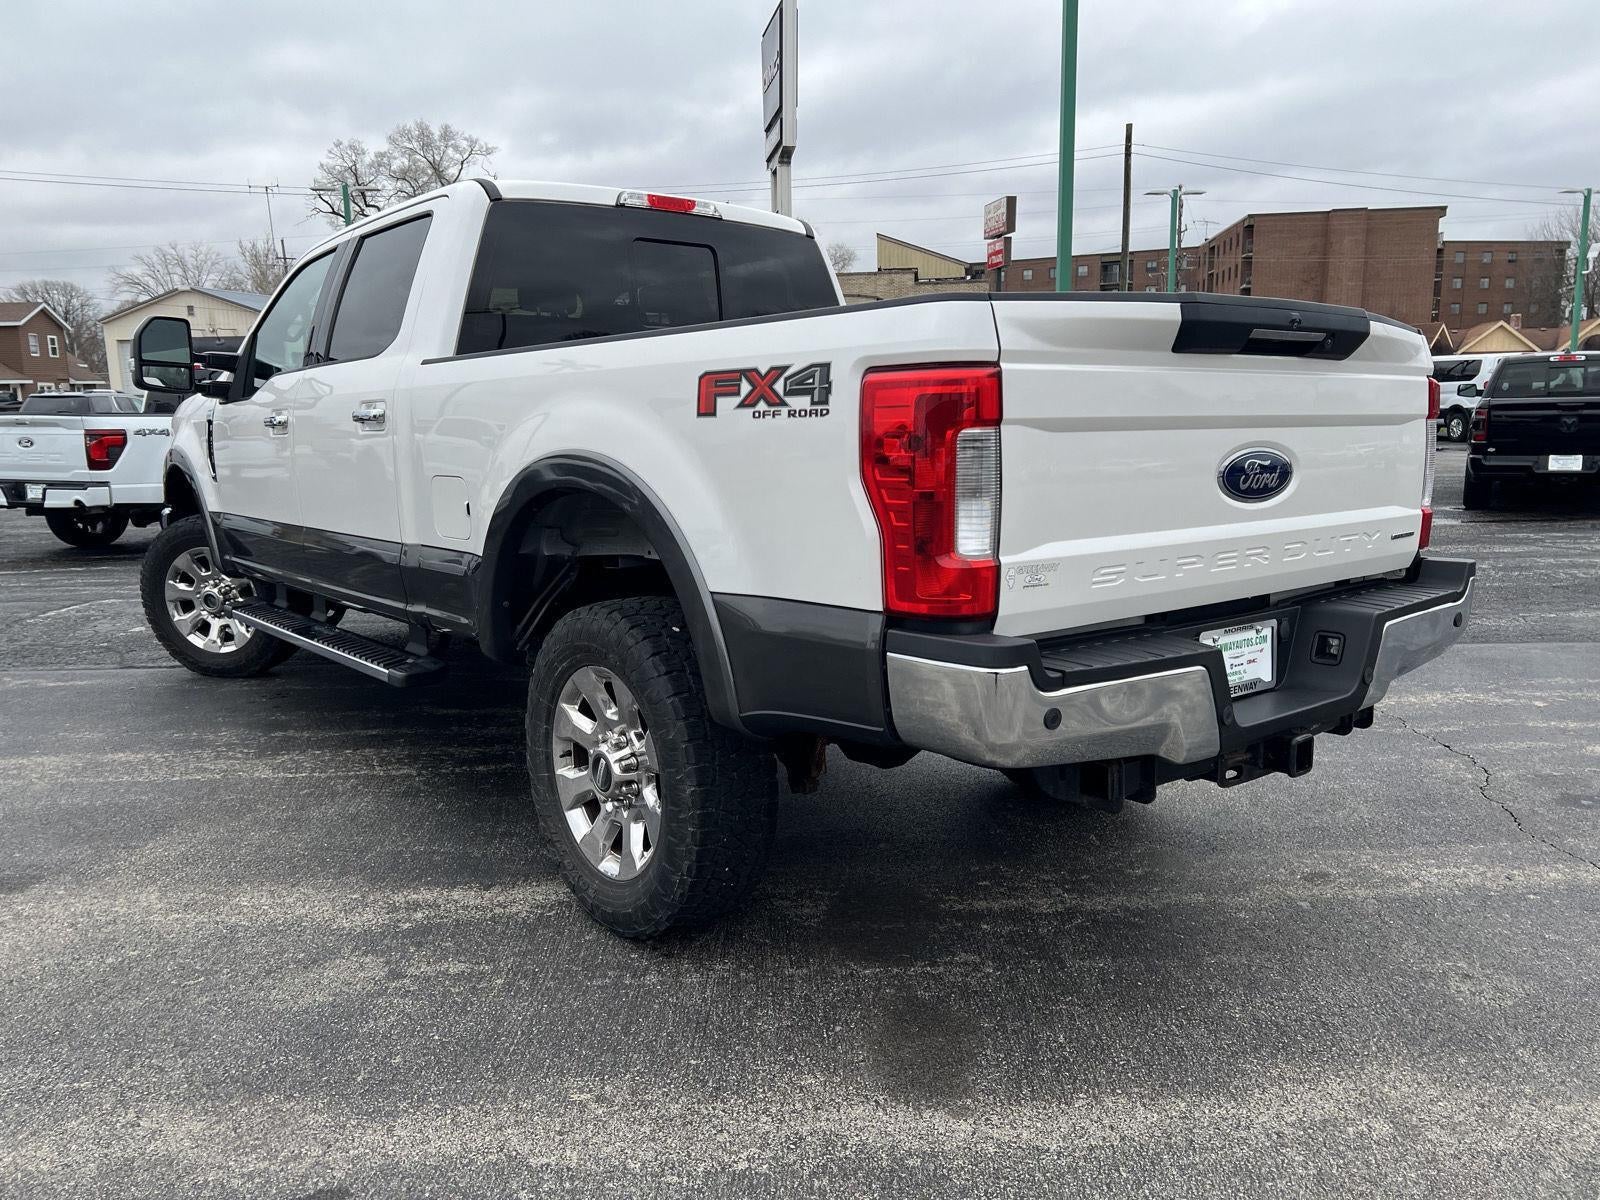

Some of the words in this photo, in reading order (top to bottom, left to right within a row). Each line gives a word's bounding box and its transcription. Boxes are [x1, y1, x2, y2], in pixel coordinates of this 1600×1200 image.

[696, 361, 832, 418] FX4
[752, 409, 782, 419] OFF
[787, 408, 830, 419] ROAD
[1239, 459, 1282, 490] Ford
[1091, 545, 1271, 589] SUPER
[1281, 529, 1382, 562] DUTY
[1223, 624, 1254, 635] MORRIS
